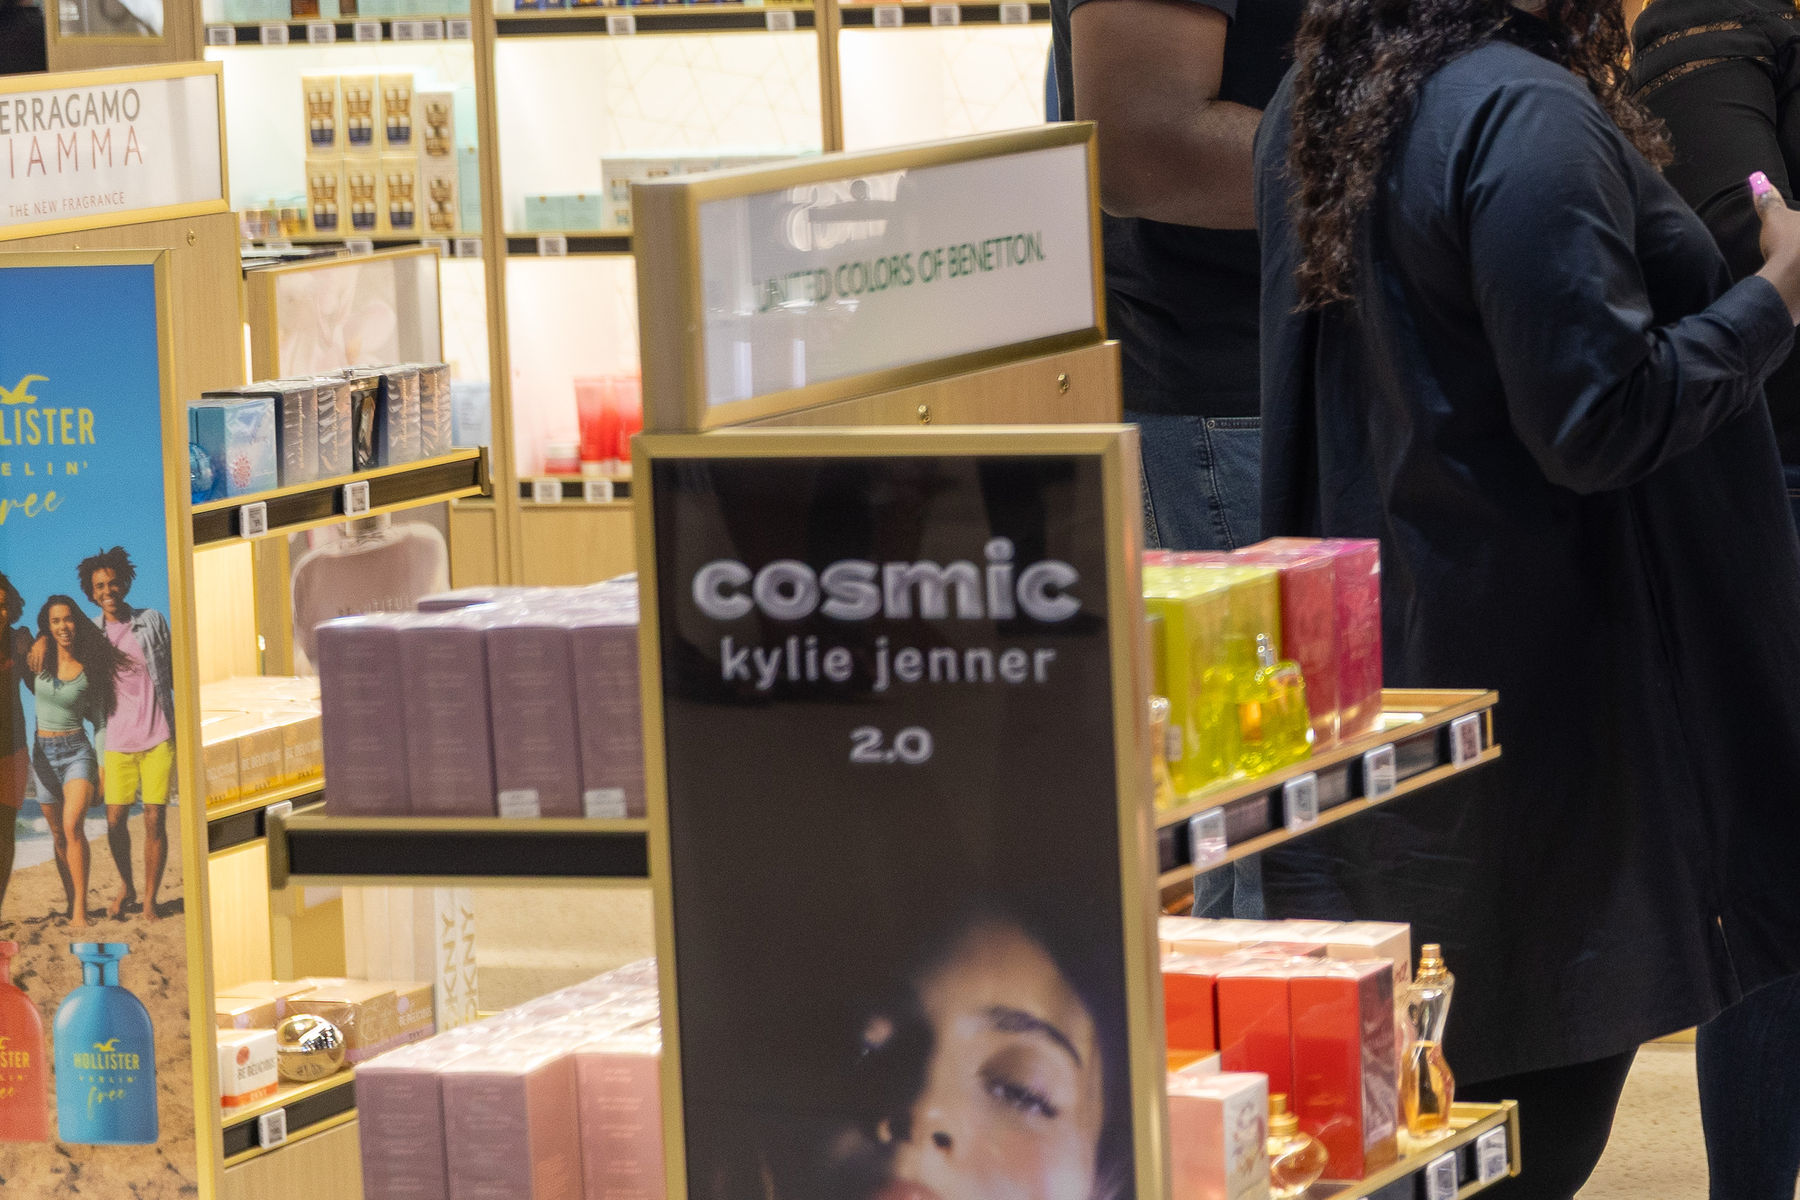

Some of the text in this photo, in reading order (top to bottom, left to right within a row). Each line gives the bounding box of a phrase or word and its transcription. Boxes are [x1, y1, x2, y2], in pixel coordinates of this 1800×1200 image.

[9, 191, 125, 217] THE NEW FRAGRANCE
[835, 252, 915, 298] COLORS
[918, 247, 946, 283] OF
[692, 536, 1081, 622] cosmic
[720, 635, 1056, 692] kylie jenner
[849, 725, 934, 764] 2.0
[74, 1053, 140, 1070] HOLLISTER
[87, 1086, 125, 1120] free
